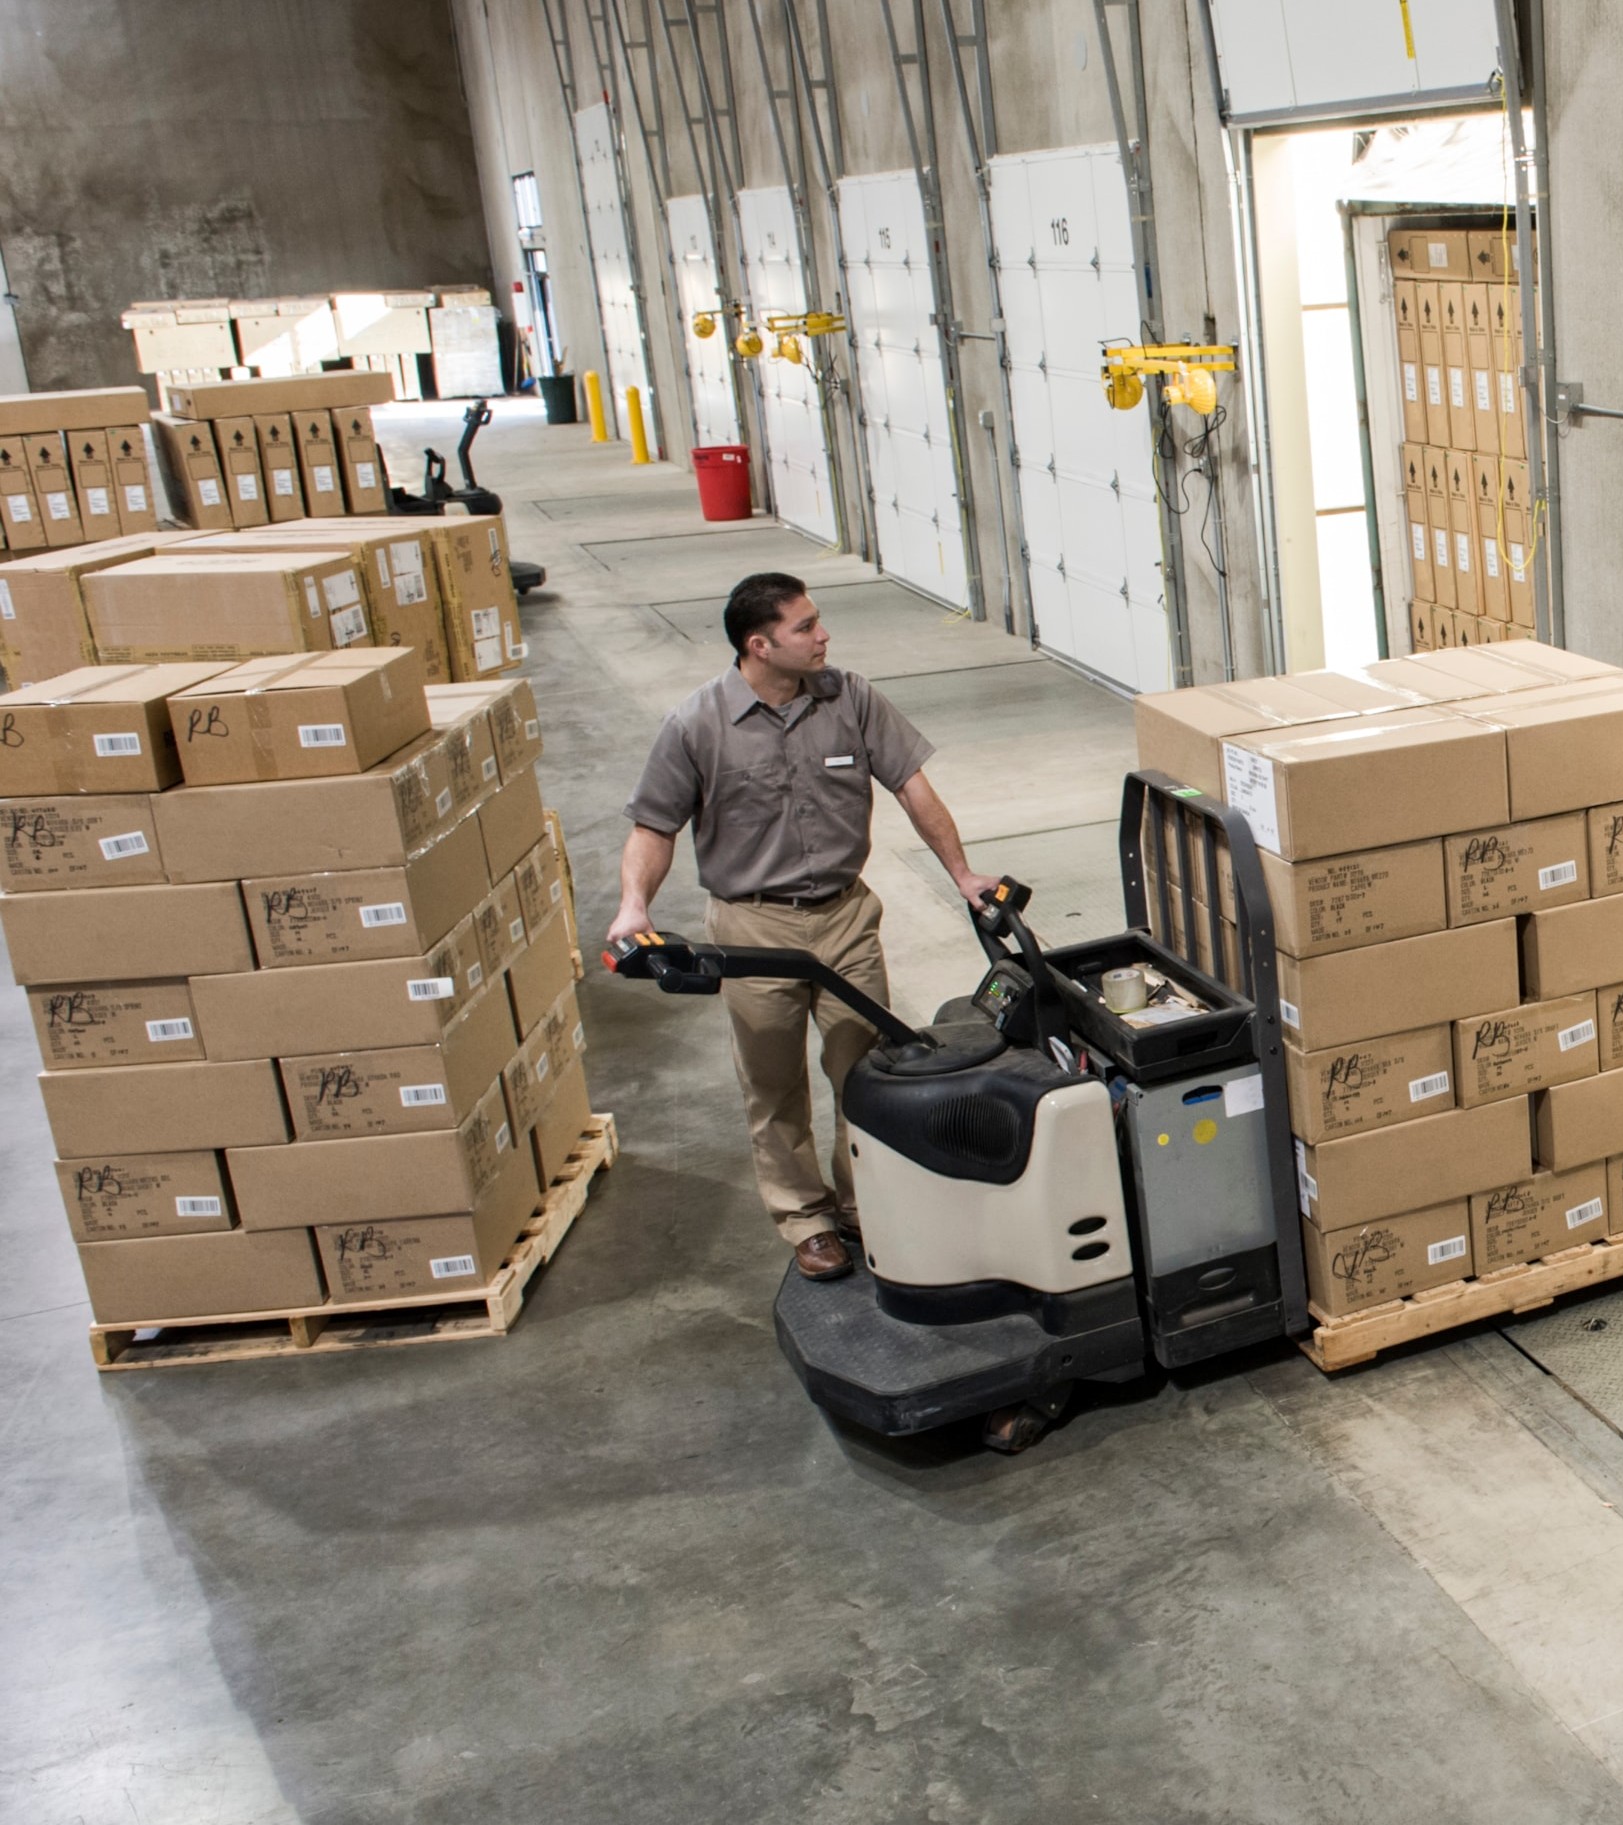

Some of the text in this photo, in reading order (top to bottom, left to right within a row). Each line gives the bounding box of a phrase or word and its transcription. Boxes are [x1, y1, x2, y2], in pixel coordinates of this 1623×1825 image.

[878, 227, 891, 249] 115
[1051, 218, 1069, 245] 116
[0, 713, 24, 747] B
[188, 706, 229, 743] RB
[12, 811, 55, 848] RB
[1464, 836, 1505, 873] RB
[266, 888, 308, 924] RB
[50, 992, 96, 1028] RB
[1472, 1021, 1510, 1060] RB
[319, 1068, 359, 1103] RB
[1326, 1054, 1363, 1100] RB
[79, 1165, 121, 1201] RB
[1486, 1185, 1525, 1224] RB
[340, 1226, 386, 1262] RB
